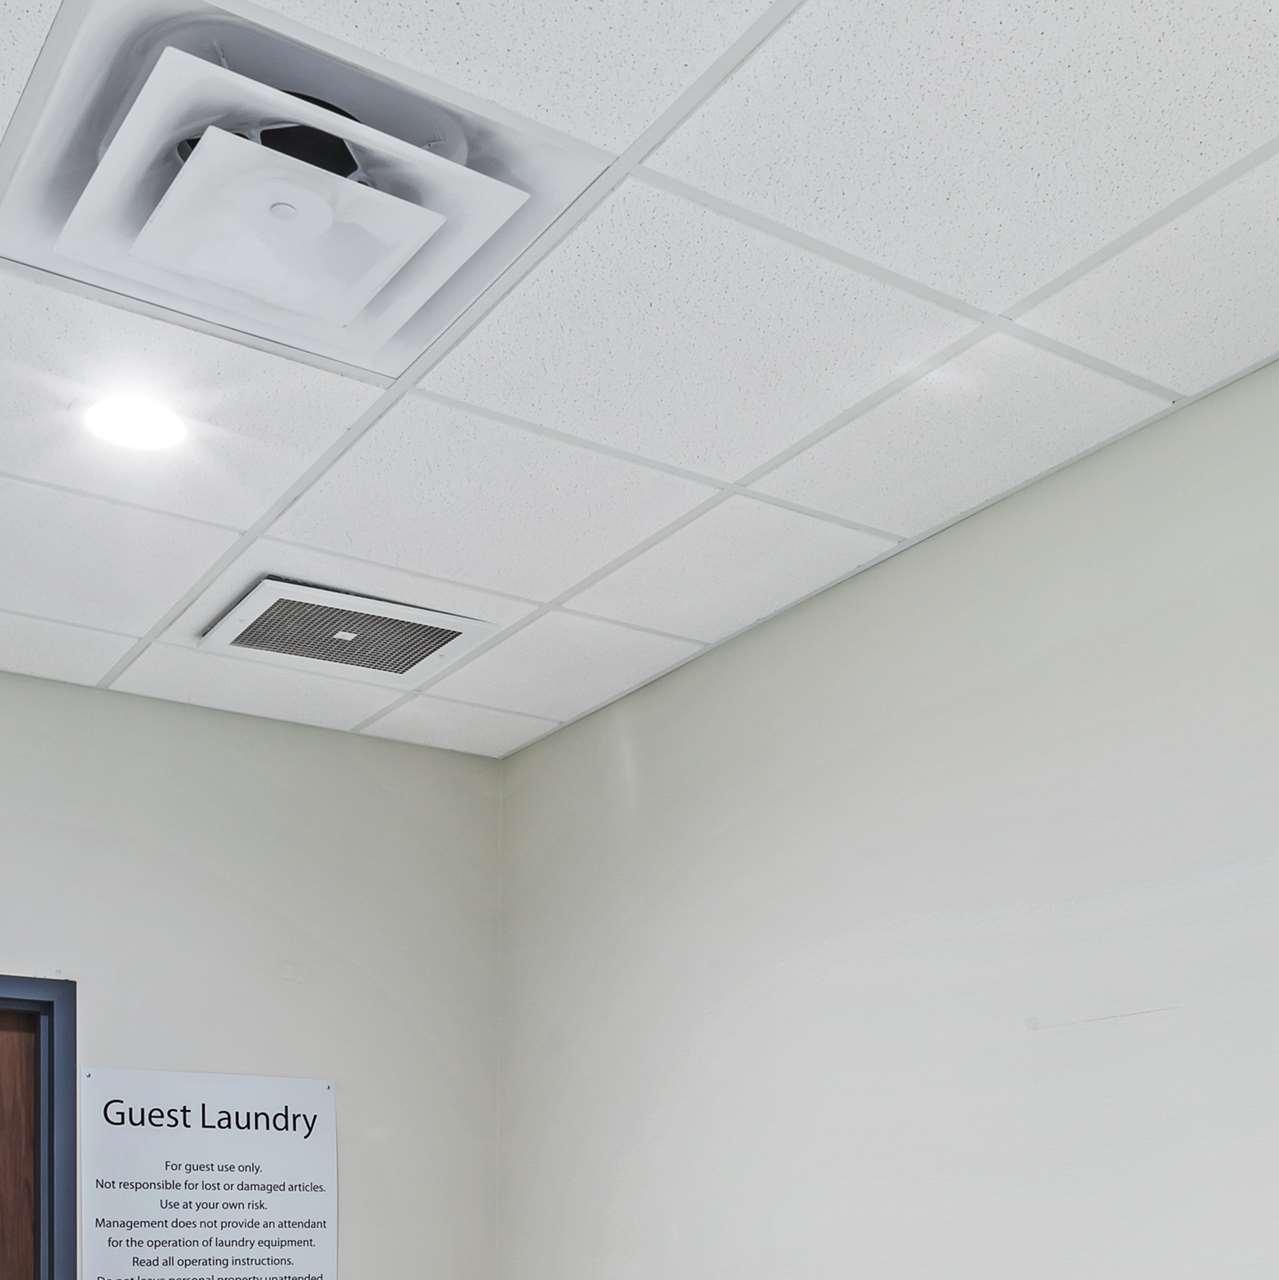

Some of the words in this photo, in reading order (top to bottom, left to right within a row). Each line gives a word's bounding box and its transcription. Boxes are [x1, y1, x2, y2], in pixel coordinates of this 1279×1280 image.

[103, 1099, 191, 1128] Guest
[201, 1103, 317, 1139] Laundry
[165, 1161, 181, 1171] For
[185, 1163, 214, 1174] guest
[217, 1164, 235, 1172] use
[238, 1163, 262, 1175] only.
[95, 1179, 115, 1189] Not
[119, 1180, 181, 1191] responsible
[184, 1180, 199, 1190] for
[201, 1180, 220, 1191] lost
[223, 1183, 234, 1191] or
[237, 1181, 286, 1194] damaged
[288, 1182, 326, 1192] articles.
[160, 1199, 180, 1209] Use
[182, 1201, 192, 1209] at
[195, 1201, 219, 1212] your
[248, 1200, 267, 1209] risk.
[95, 1218, 168, 1230] Management
[171, 1218, 197, 1228] does
[200, 1220, 217, 1228] not
[220, 1218, 260, 1230] provide
[263, 1220, 275, 1228] an
[278, 1219, 326, 1228] attendant
[108, 1237, 123, 1247] for
[126, 1237, 144, 1247] the
[146, 1238, 199, 1249] operation
[202, 1237, 213, 1247] of
[215, 1237, 255, 1249] laundry
[257, 1237, 316, 1249] equipment.
[132, 1256, 159, 1266] Read
[162, 1256, 174, 1266] all
[177, 1256, 229, 1268] operating
[232, 1256, 294, 1266] instructions.
